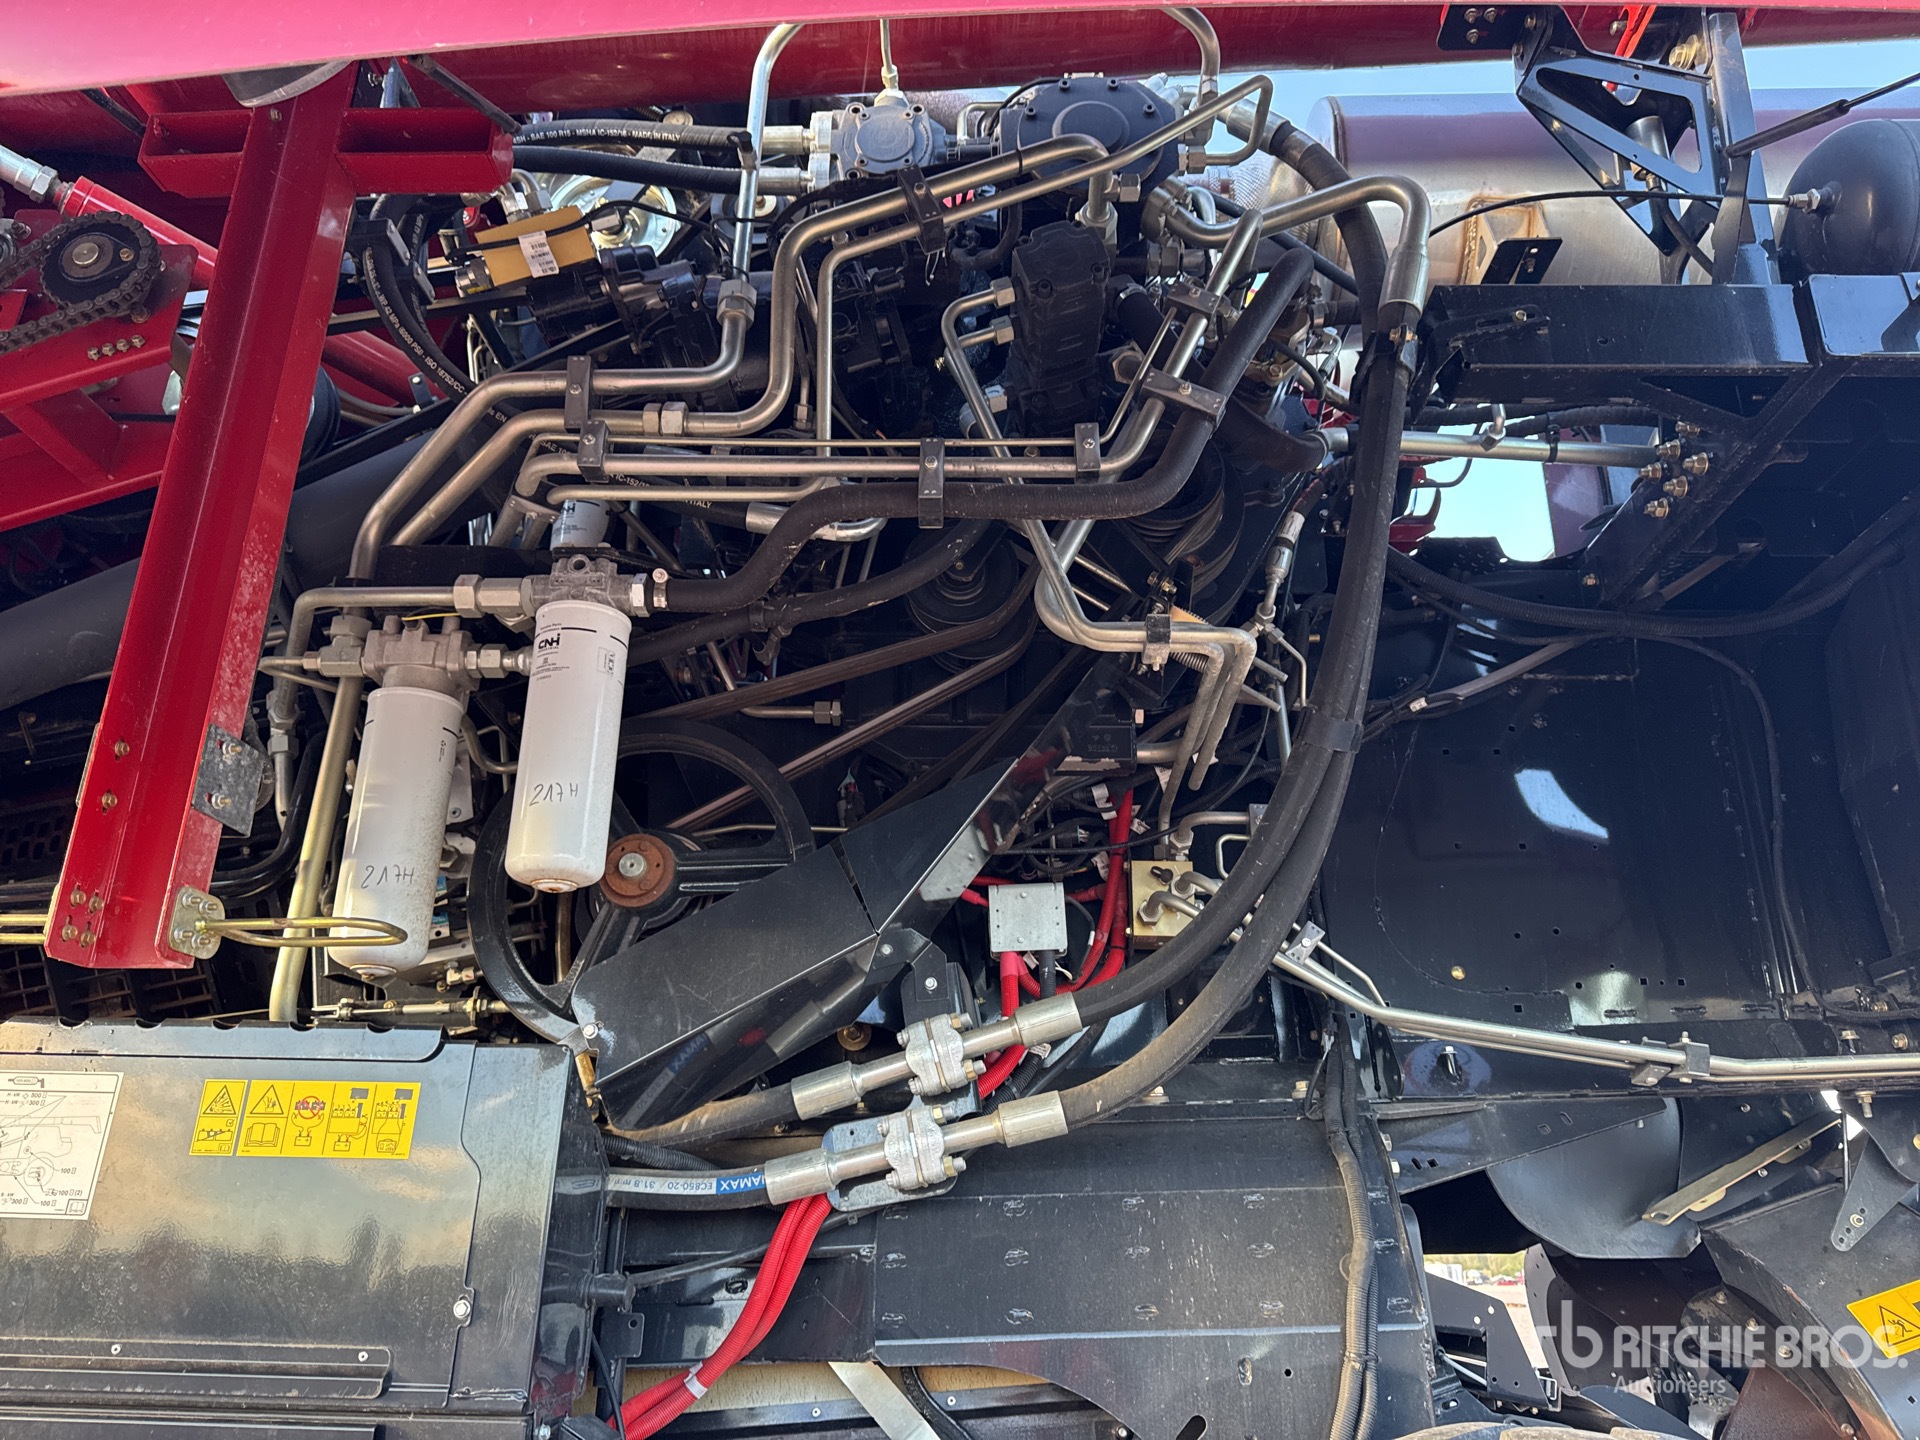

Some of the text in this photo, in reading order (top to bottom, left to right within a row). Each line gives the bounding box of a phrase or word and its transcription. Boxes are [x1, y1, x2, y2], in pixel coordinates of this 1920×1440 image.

[531, 132, 546, 142] SAE
[546, 131, 558, 139] 100
[653, 132, 661, 140] IN
[662, 132, 680, 142] ITALY
[378, 293, 388, 307] WP
[384, 306, 392, 315] 42
[389, 313, 402, 329] MPa
[424, 356, 438, 370] ISO
[436, 367, 466, 394] 18752/CC
[495, 411, 508, 423] EN
[540, 439, 558, 452] SAE
[667, 1181, 713, 1190] EC850-20
